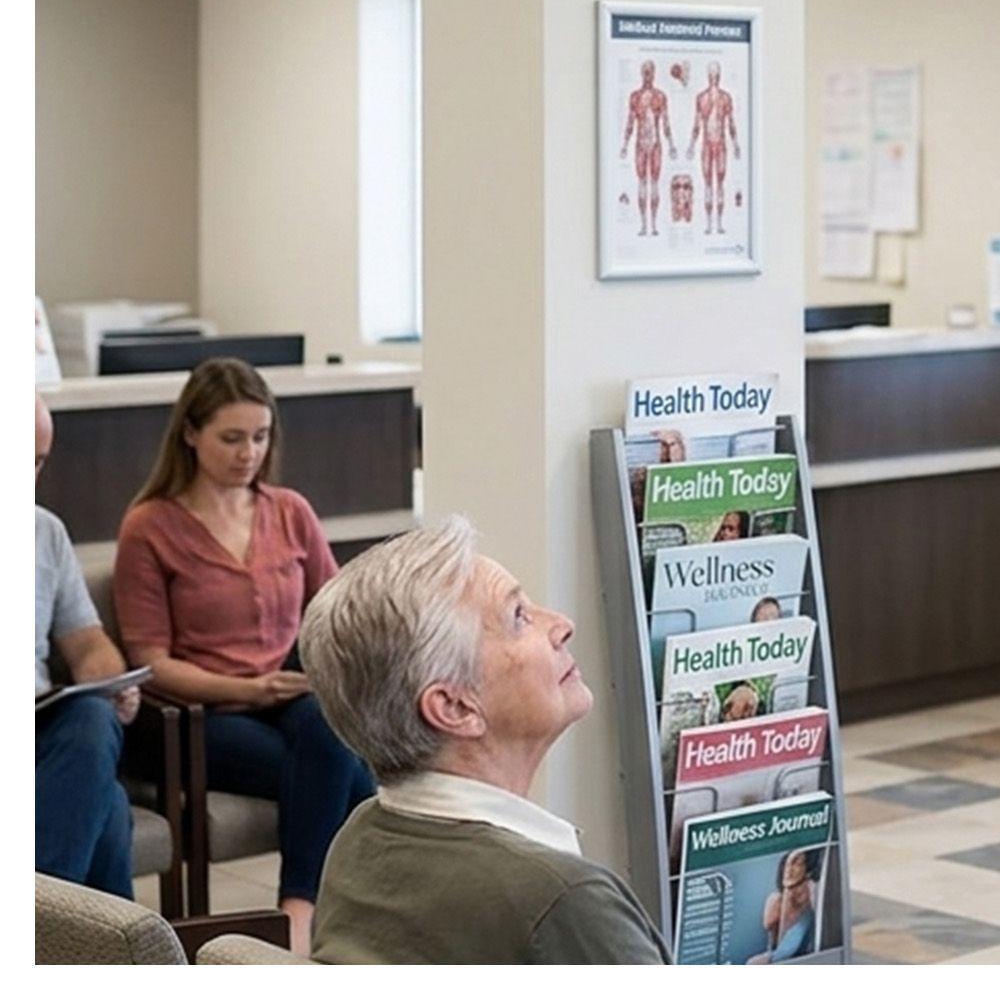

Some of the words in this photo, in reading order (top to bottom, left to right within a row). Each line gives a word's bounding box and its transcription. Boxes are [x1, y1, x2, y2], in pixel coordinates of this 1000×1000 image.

[634, 385, 704, 417] Health
[709, 382, 772, 415] Today
[652, 471, 724, 504] Health
[663, 556, 775, 588] Wellness
[673, 639, 743, 674] Health
[748, 632, 809, 664] Today
[685, 732, 756, 769] Health
[762, 726, 822, 755] Today
